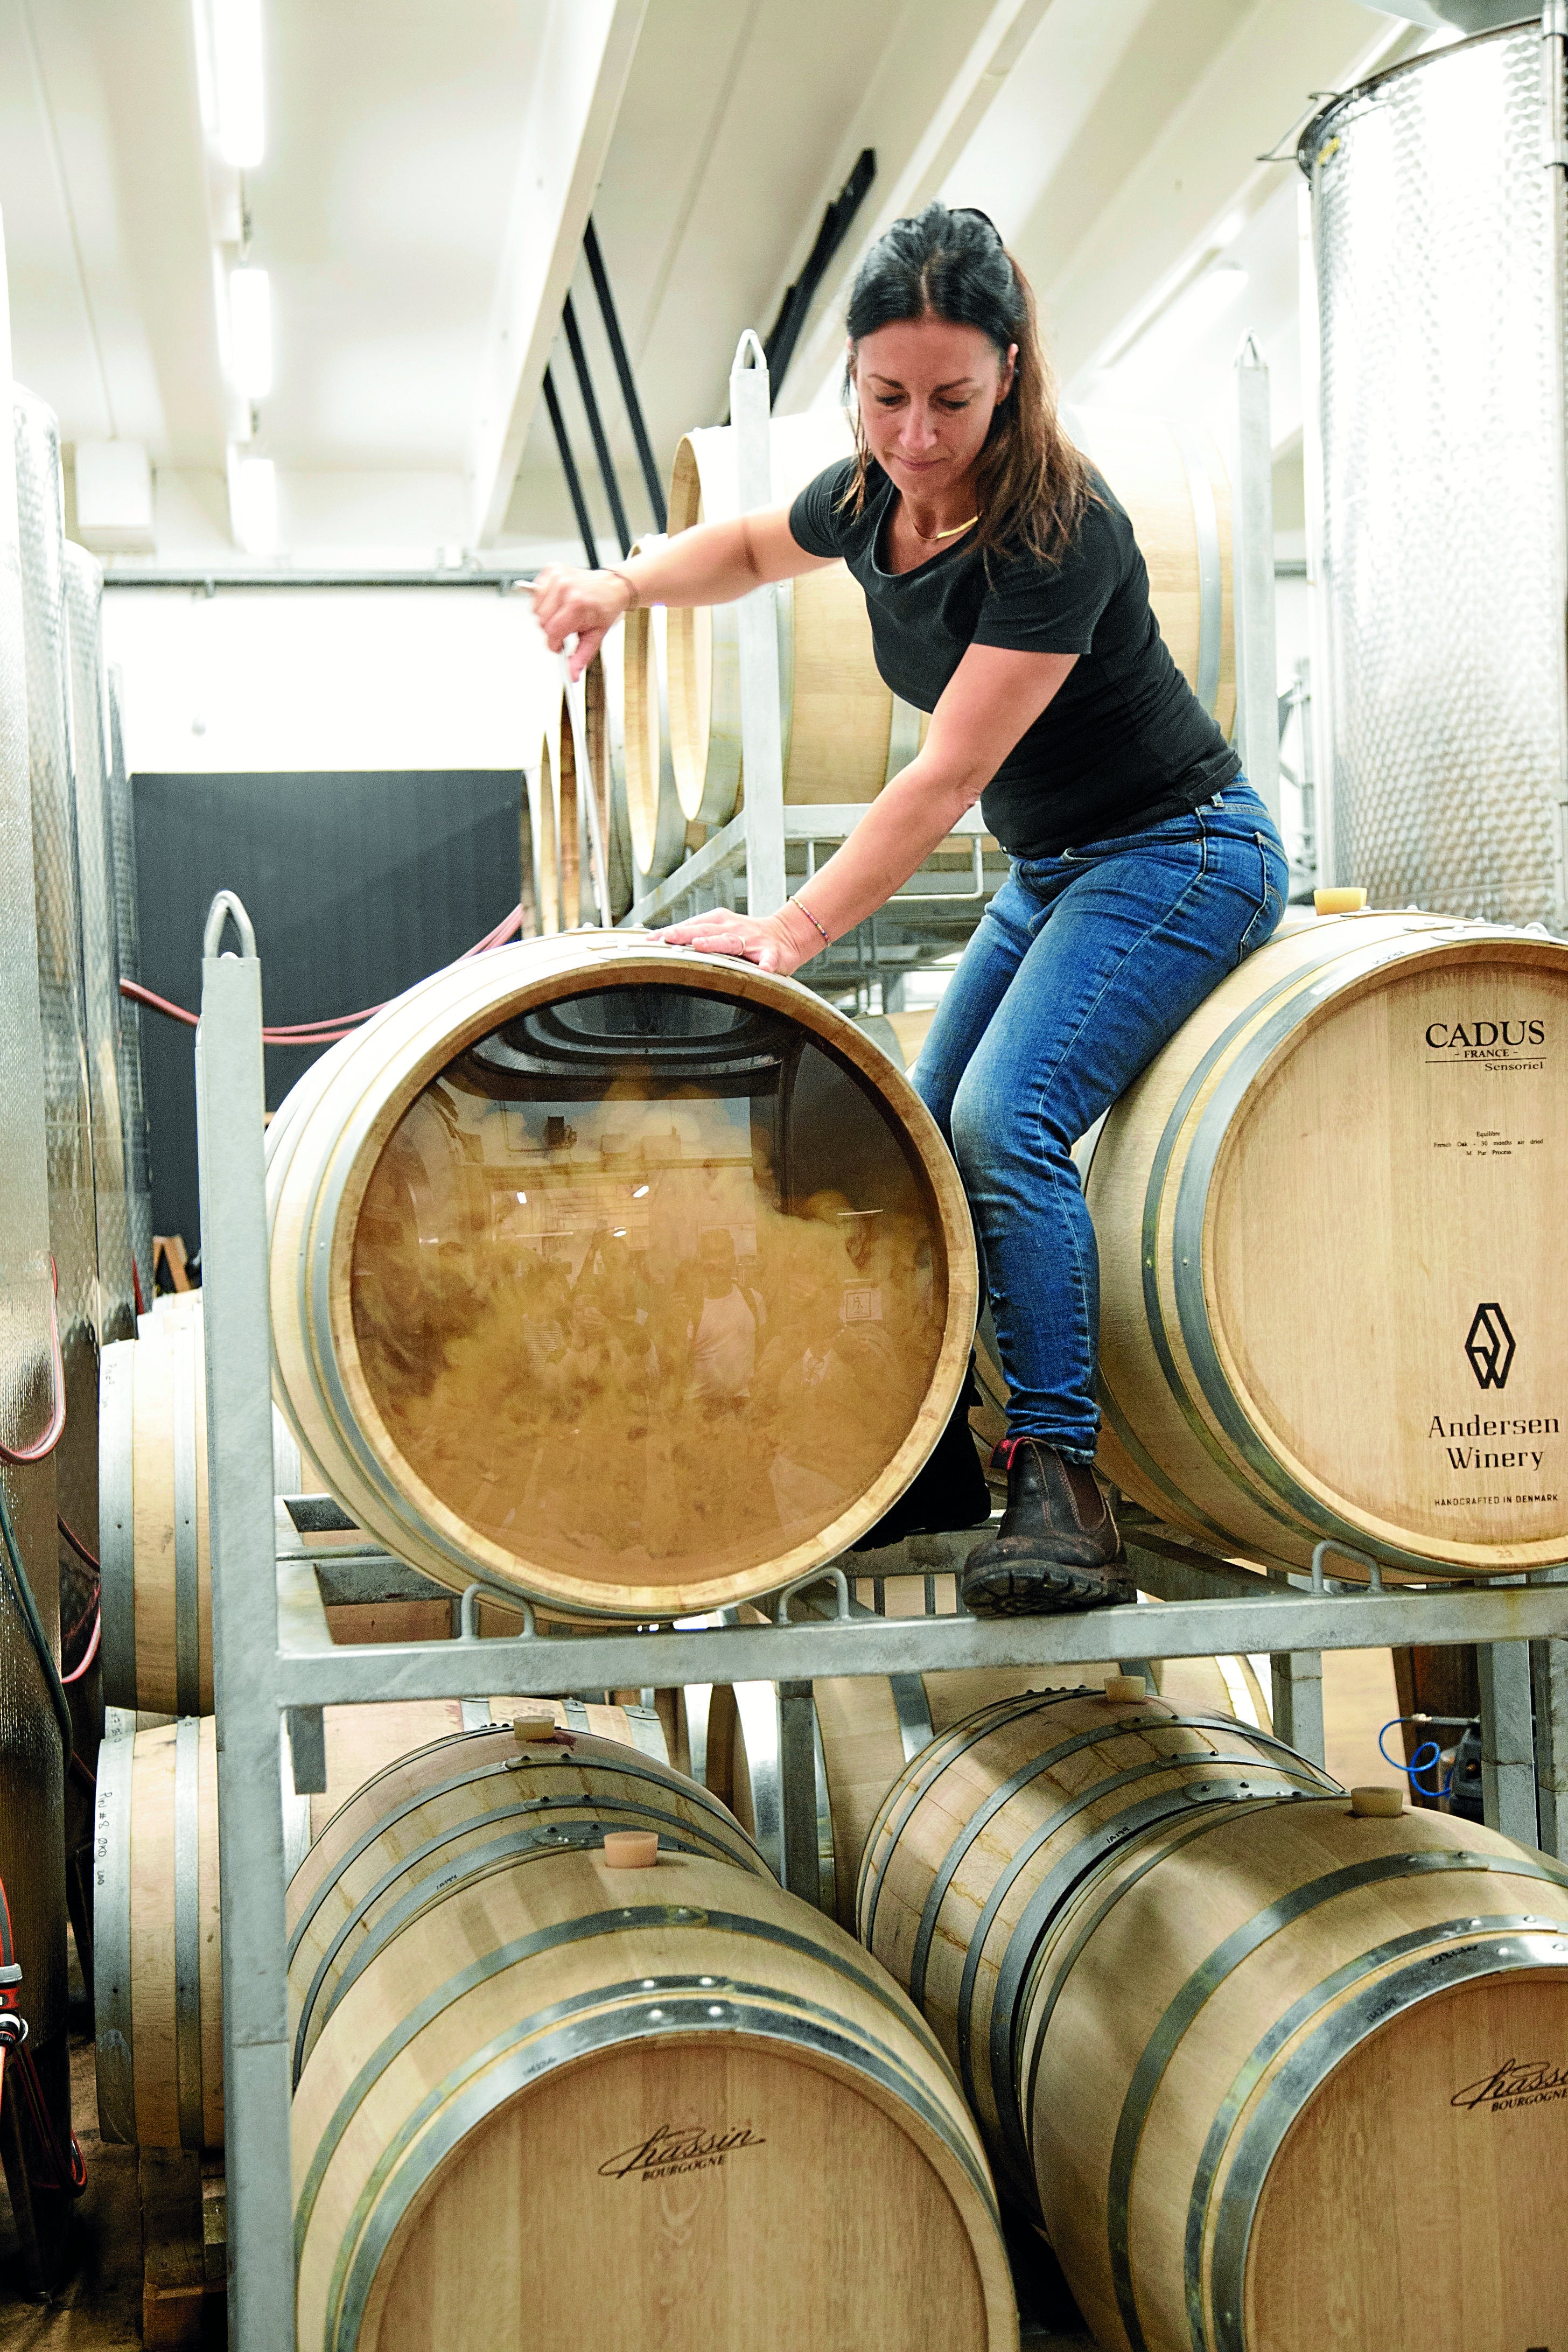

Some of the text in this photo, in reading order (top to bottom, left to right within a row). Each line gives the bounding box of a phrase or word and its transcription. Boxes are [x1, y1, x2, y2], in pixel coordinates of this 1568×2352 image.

[1425, 1020, 1545, 1048] CADUS
[1464, 1049, 1509, 1058] FRANCE
[1485, 1061, 1544, 1071] Sensoriel
[1428, 1415, 1559, 1438] Andersen
[1446, 1447, 1545, 1471] Winery
[1435, 1496, 1500, 1507] HANDCRAFTED
[1516, 1494, 1558, 1503] DENMARK
